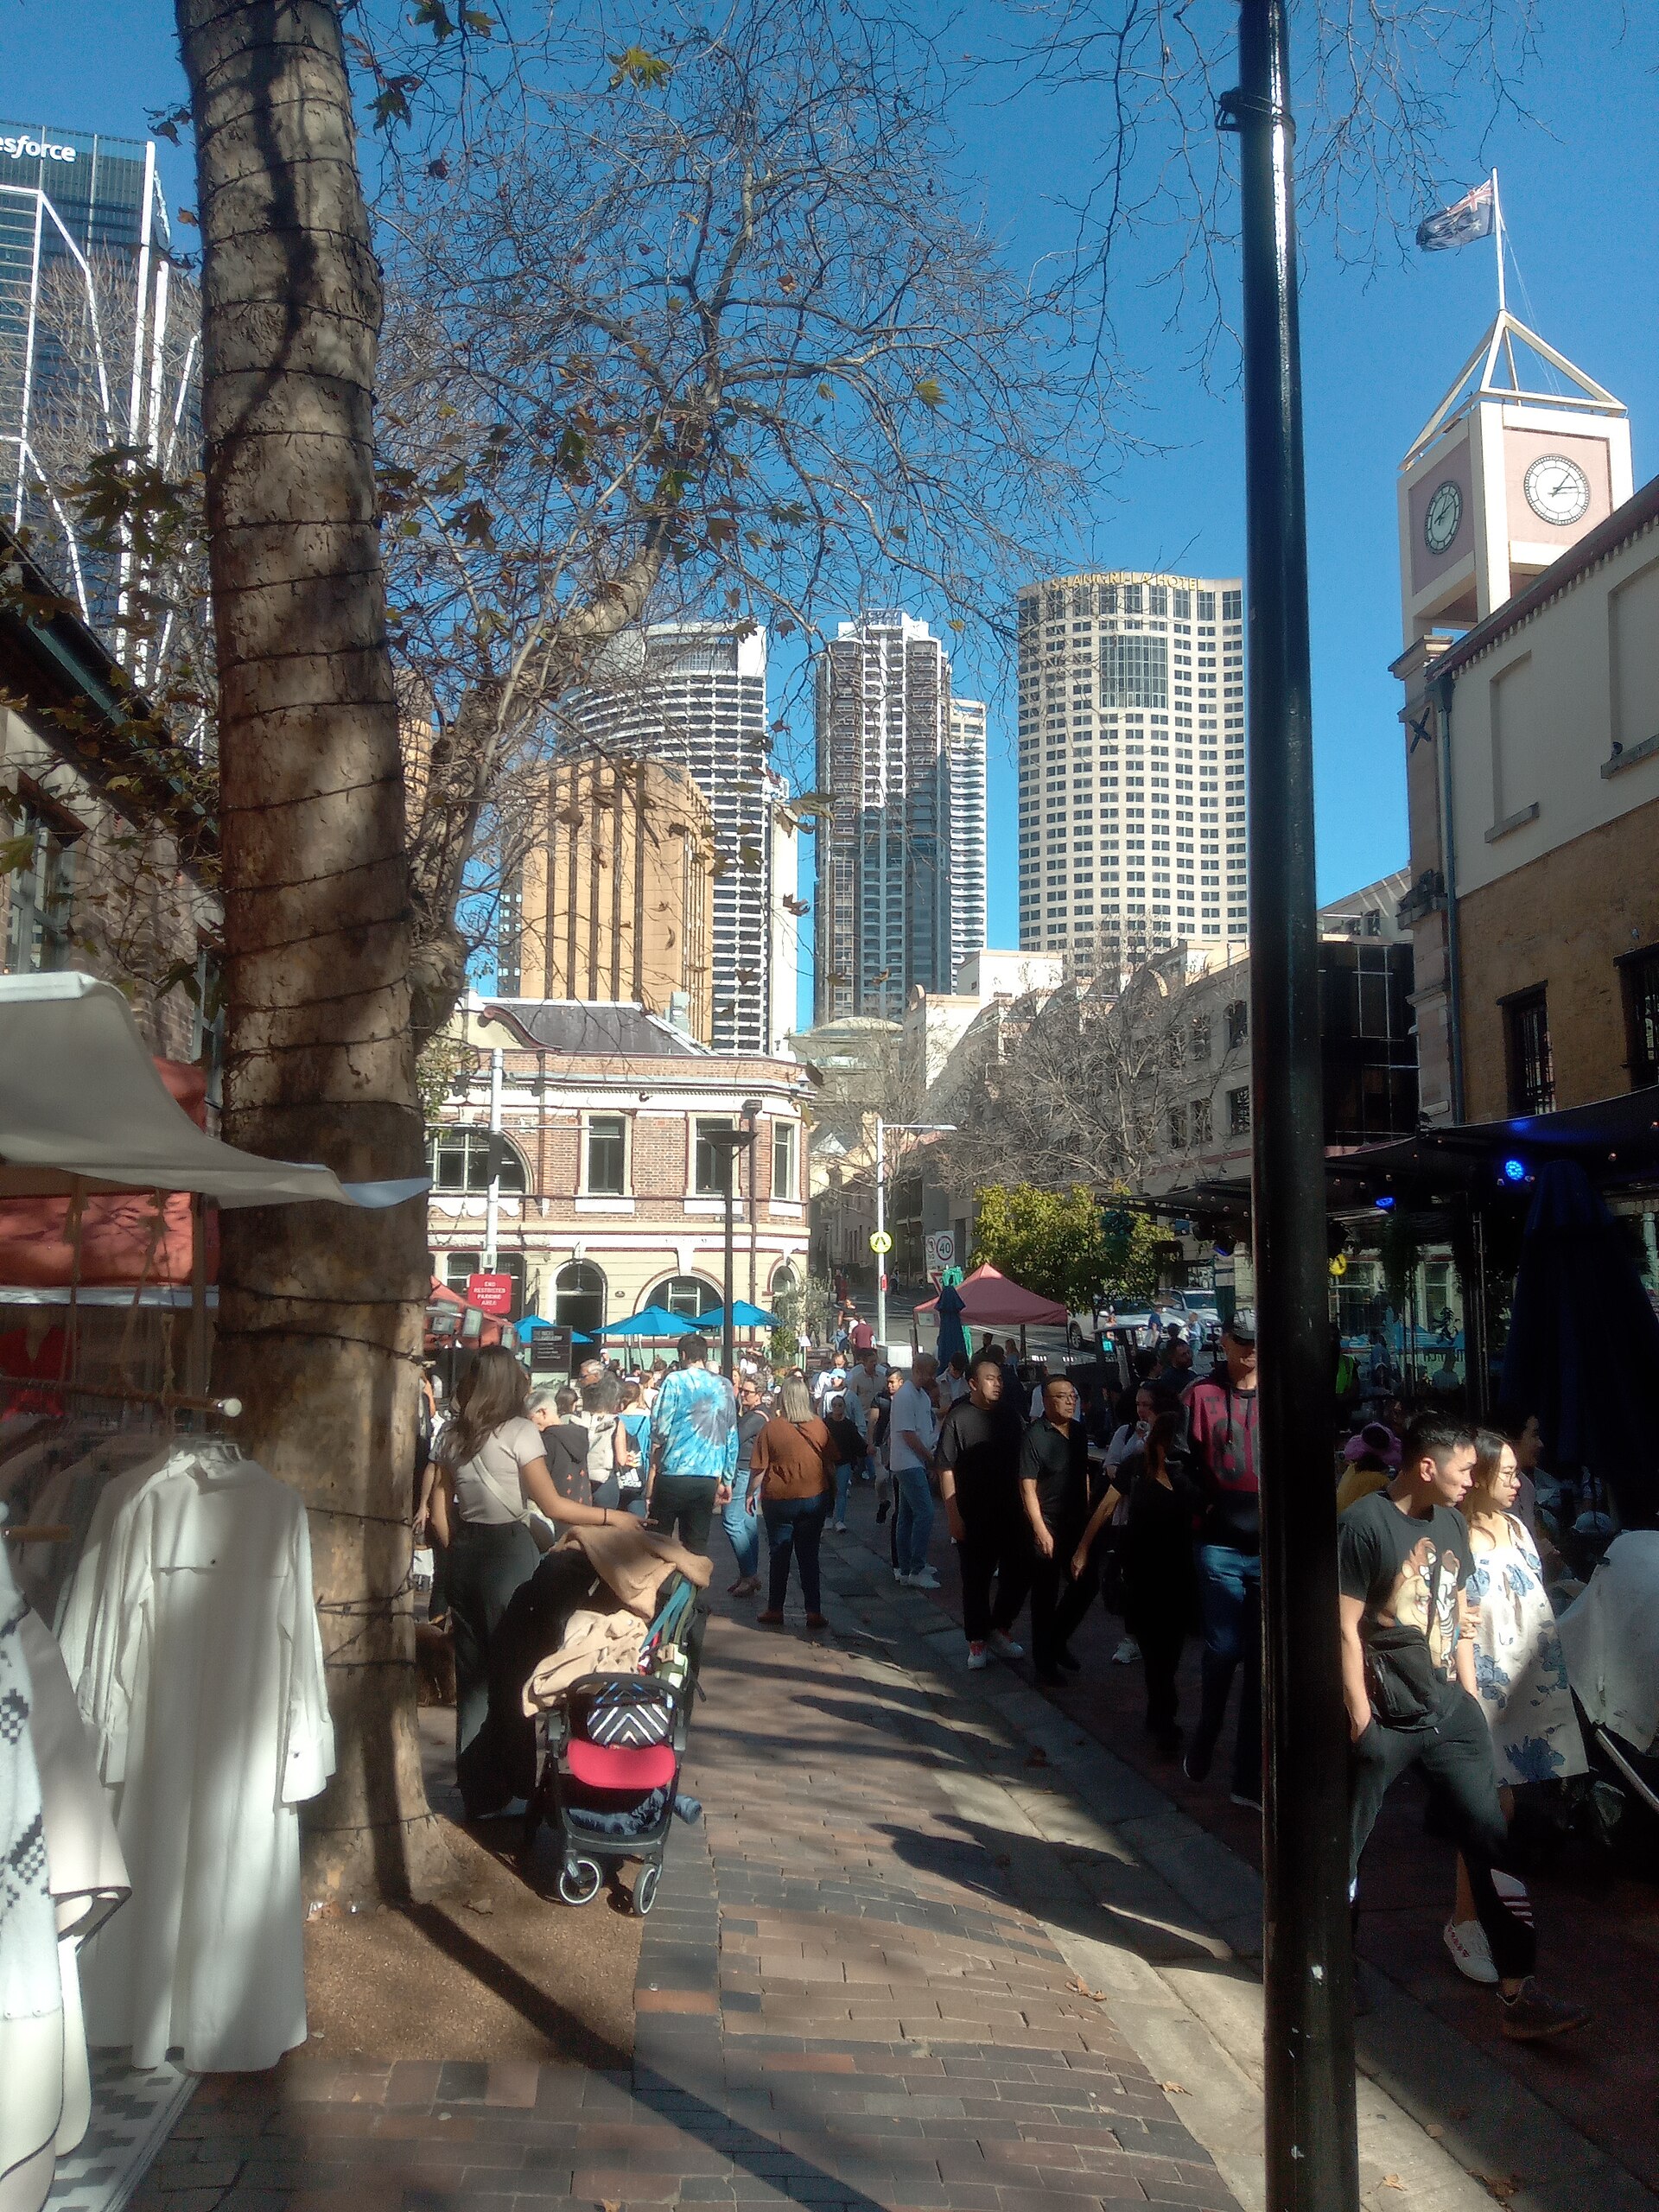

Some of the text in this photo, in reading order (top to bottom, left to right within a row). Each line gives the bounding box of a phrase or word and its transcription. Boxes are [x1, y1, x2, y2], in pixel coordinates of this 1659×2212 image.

[0, 135, 76, 162] sforce
[1051, 572, 1205, 592] SHANGRI-LA HOTEL
[939, 1243, 951, 1254] 40
